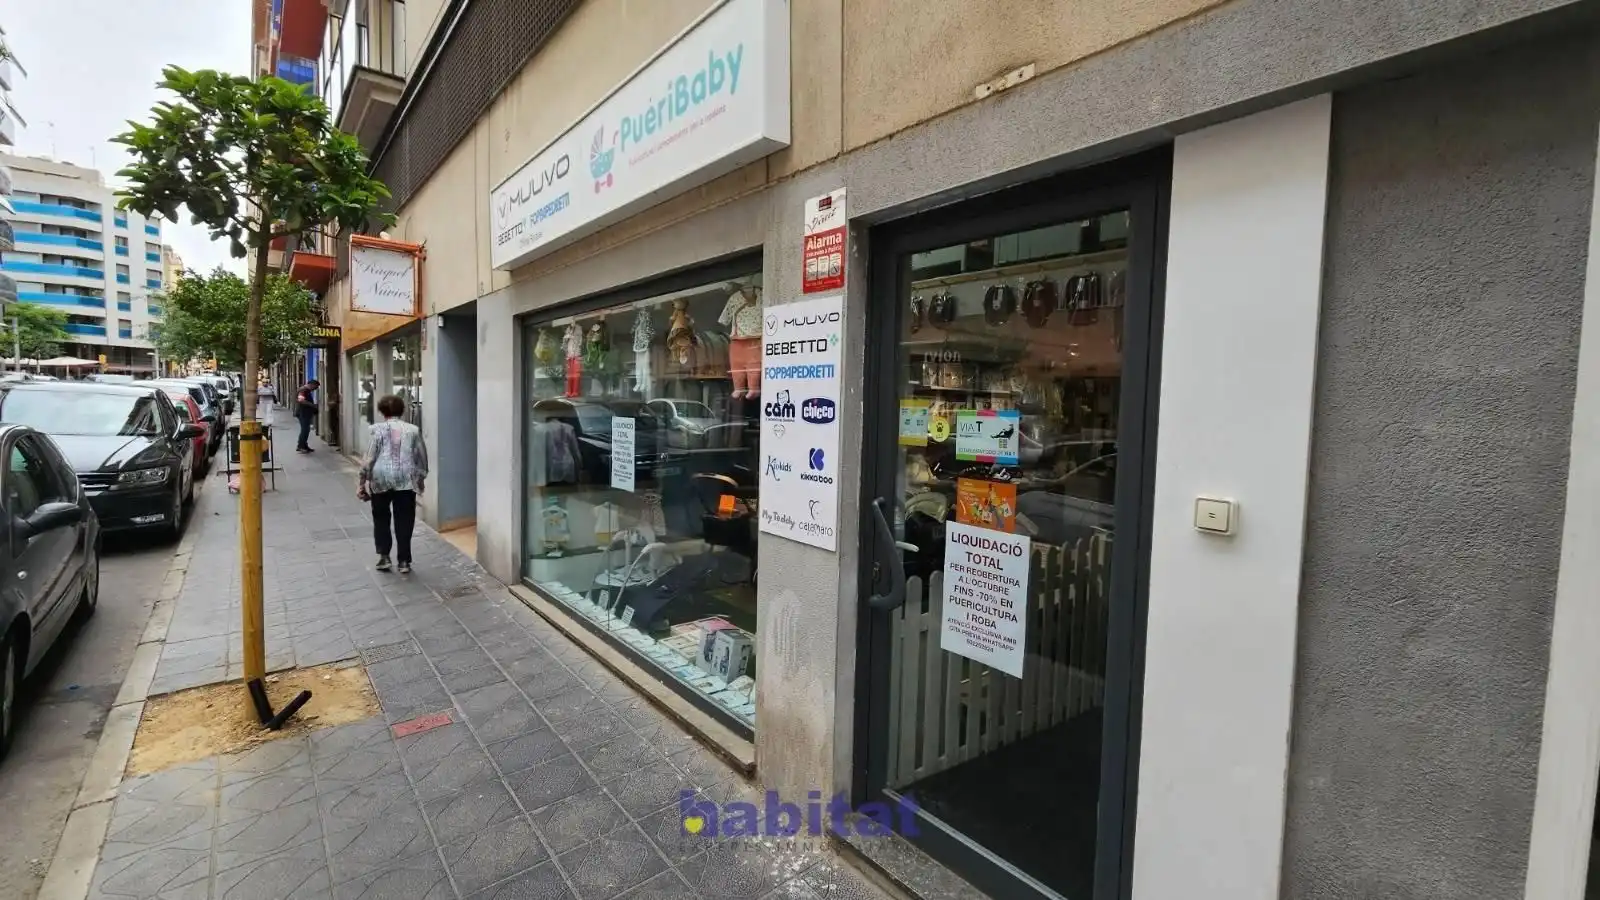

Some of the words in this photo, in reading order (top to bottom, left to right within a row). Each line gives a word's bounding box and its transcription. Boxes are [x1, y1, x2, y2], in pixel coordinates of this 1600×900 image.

[509, 154, 570, 212] MUUVO
[498, 222, 523, 246] BEBETTO
[806, 232, 842, 251] Alarma
[364, 261, 413, 281] Raquel
[783, 312, 840, 328] MUUVO
[765, 338, 828, 356] BEBETTO
[764, 364, 835, 379] FOPPAPEDRETTI
[803, 400, 835, 419] chicco
[960, 422, 975, 432] VIA
[976, 420, 983, 432] T
[762, 509, 773, 524] My
[951, 531, 1023, 557] LIQUIDACIÓ
[965, 551, 1004, 571] TOTAL
[950, 562, 965, 573] PER
[966, 567, 1021, 588] REOBERTURA
[958, 575, 964, 583] A
[965, 577, 1010, 596] L'OCTUBRE
[954, 585, 974, 597] FINS
[975, 590, 998, 605] -70%
[1000, 598, 1014, 609] EN
[949, 594, 1018, 624] PUERICULTURA
[971, 614, 997, 630] ROBA
[971, 625, 1002, 640] EXCLUSIVA
[1003, 636, 1017, 645] AMB
[982, 636, 1015, 651] WHATSAPP
